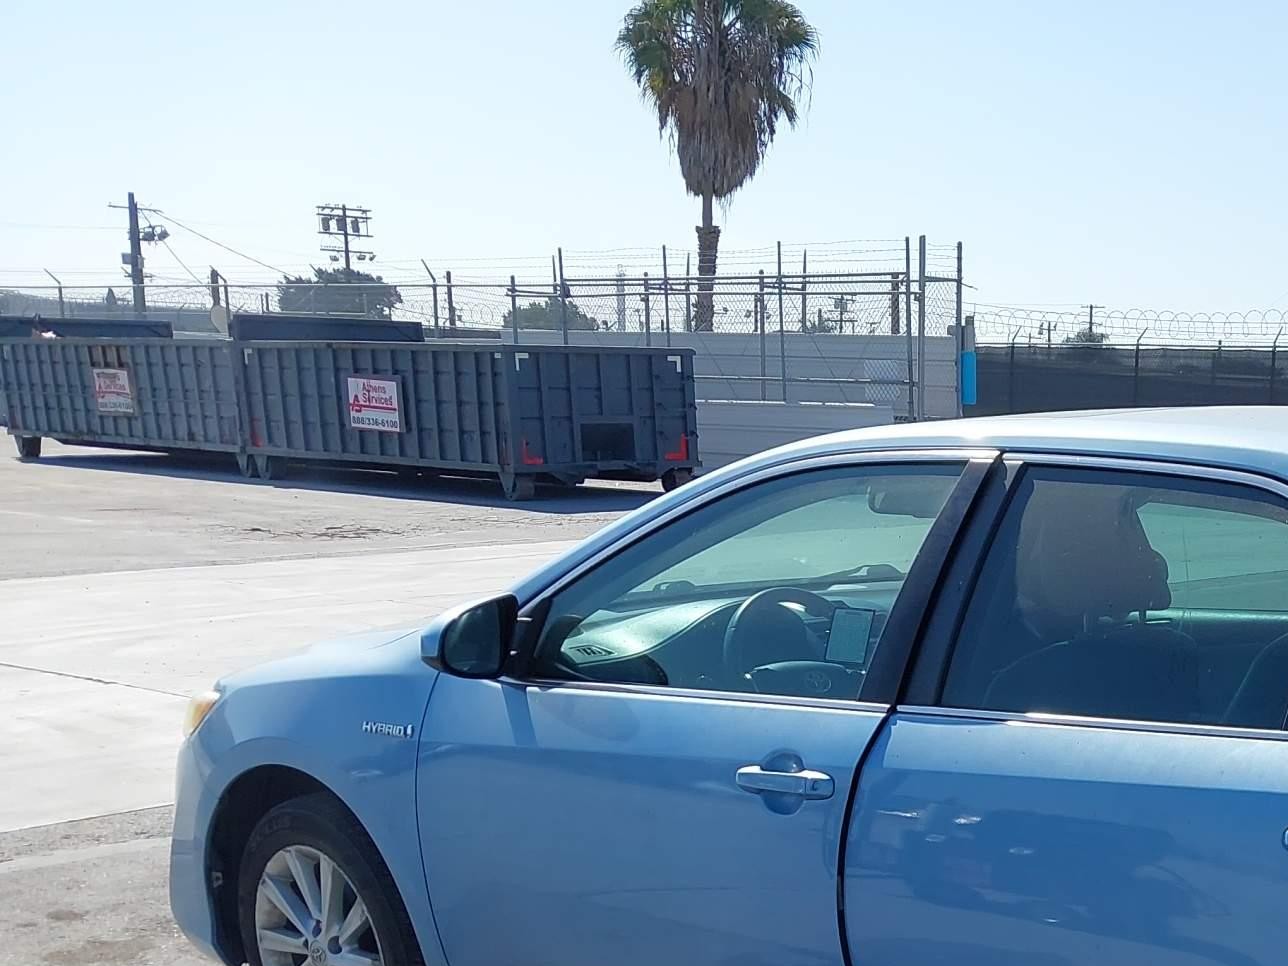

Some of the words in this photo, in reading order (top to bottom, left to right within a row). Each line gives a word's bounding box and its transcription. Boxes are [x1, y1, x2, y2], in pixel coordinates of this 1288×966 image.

[362, 381, 386, 394] Athens
[352, 415, 398, 428] 888/336-6100
[362, 721, 404, 737] HYBRID
